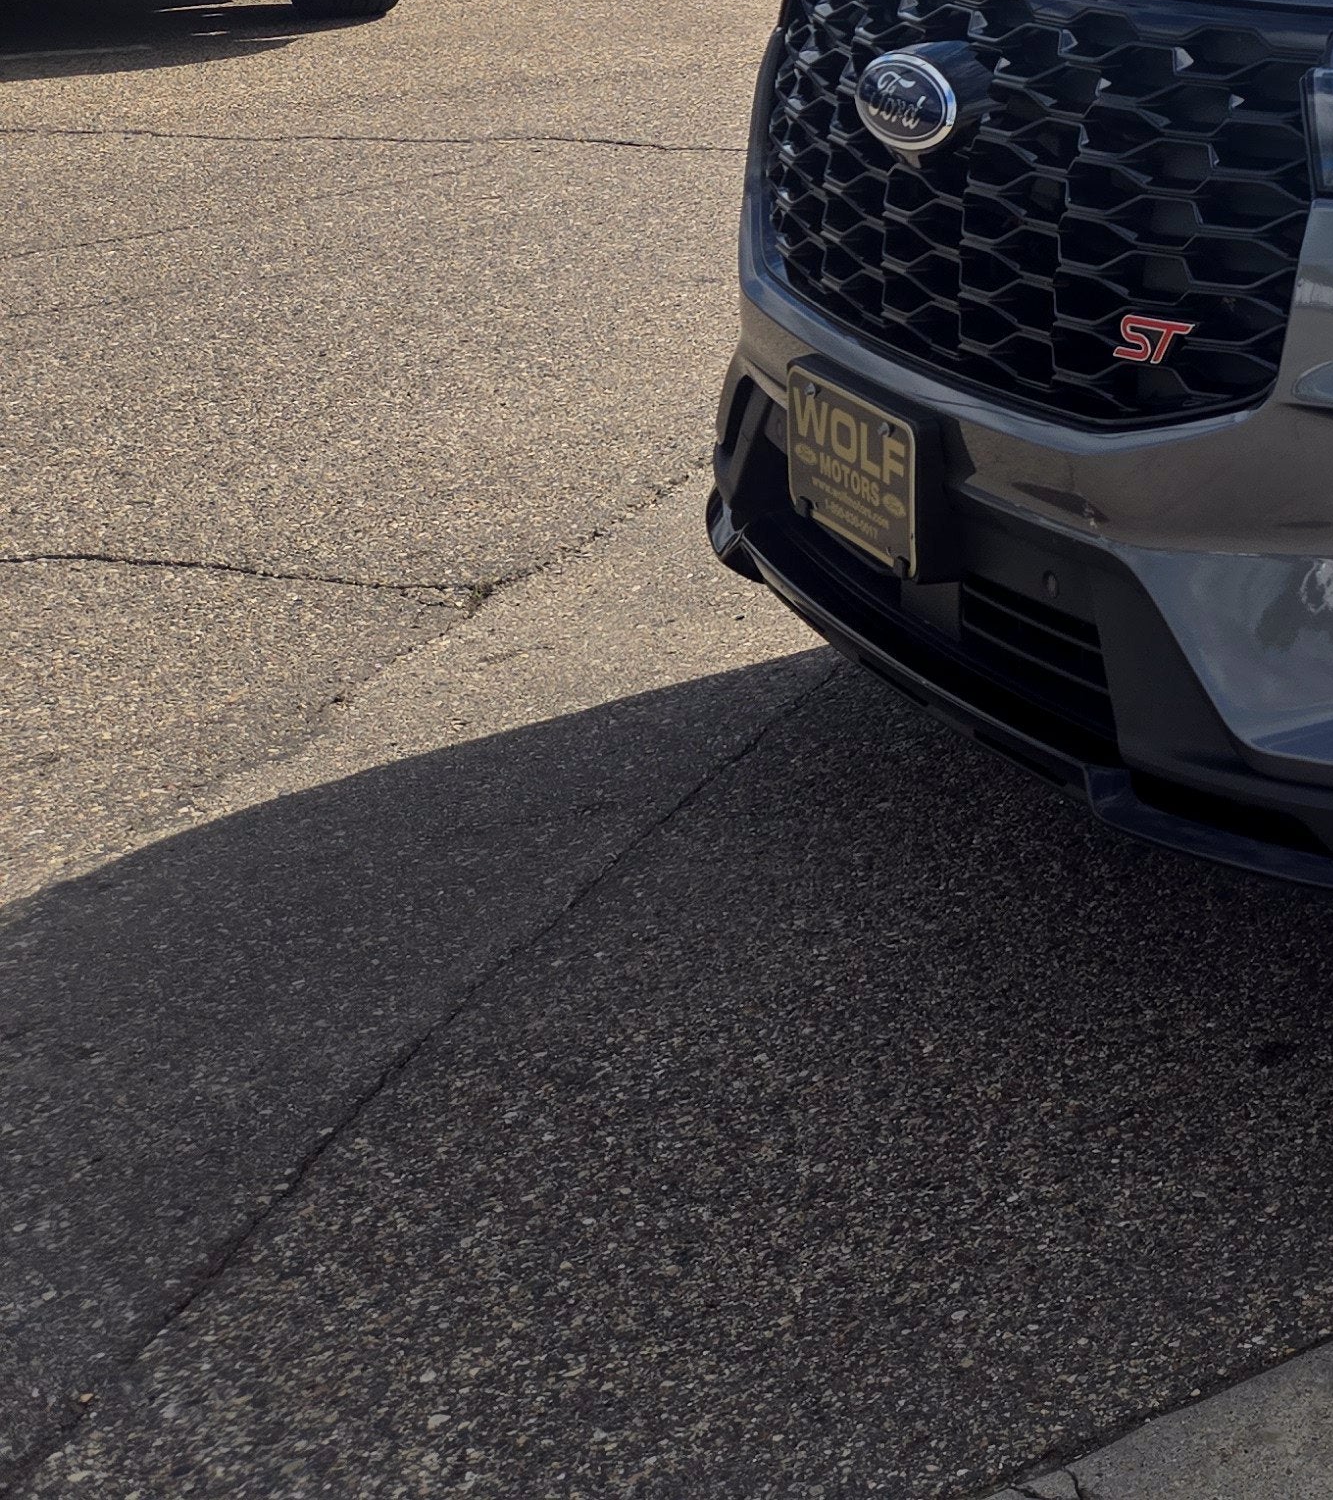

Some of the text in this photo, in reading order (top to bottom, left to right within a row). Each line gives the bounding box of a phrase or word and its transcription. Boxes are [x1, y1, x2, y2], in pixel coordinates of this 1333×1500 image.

[868, 71, 927, 130] Ford
[1112, 314, 1195, 364] ST
[793, 387, 905, 485] WOLF
[819, 452, 880, 507] MOTORS
